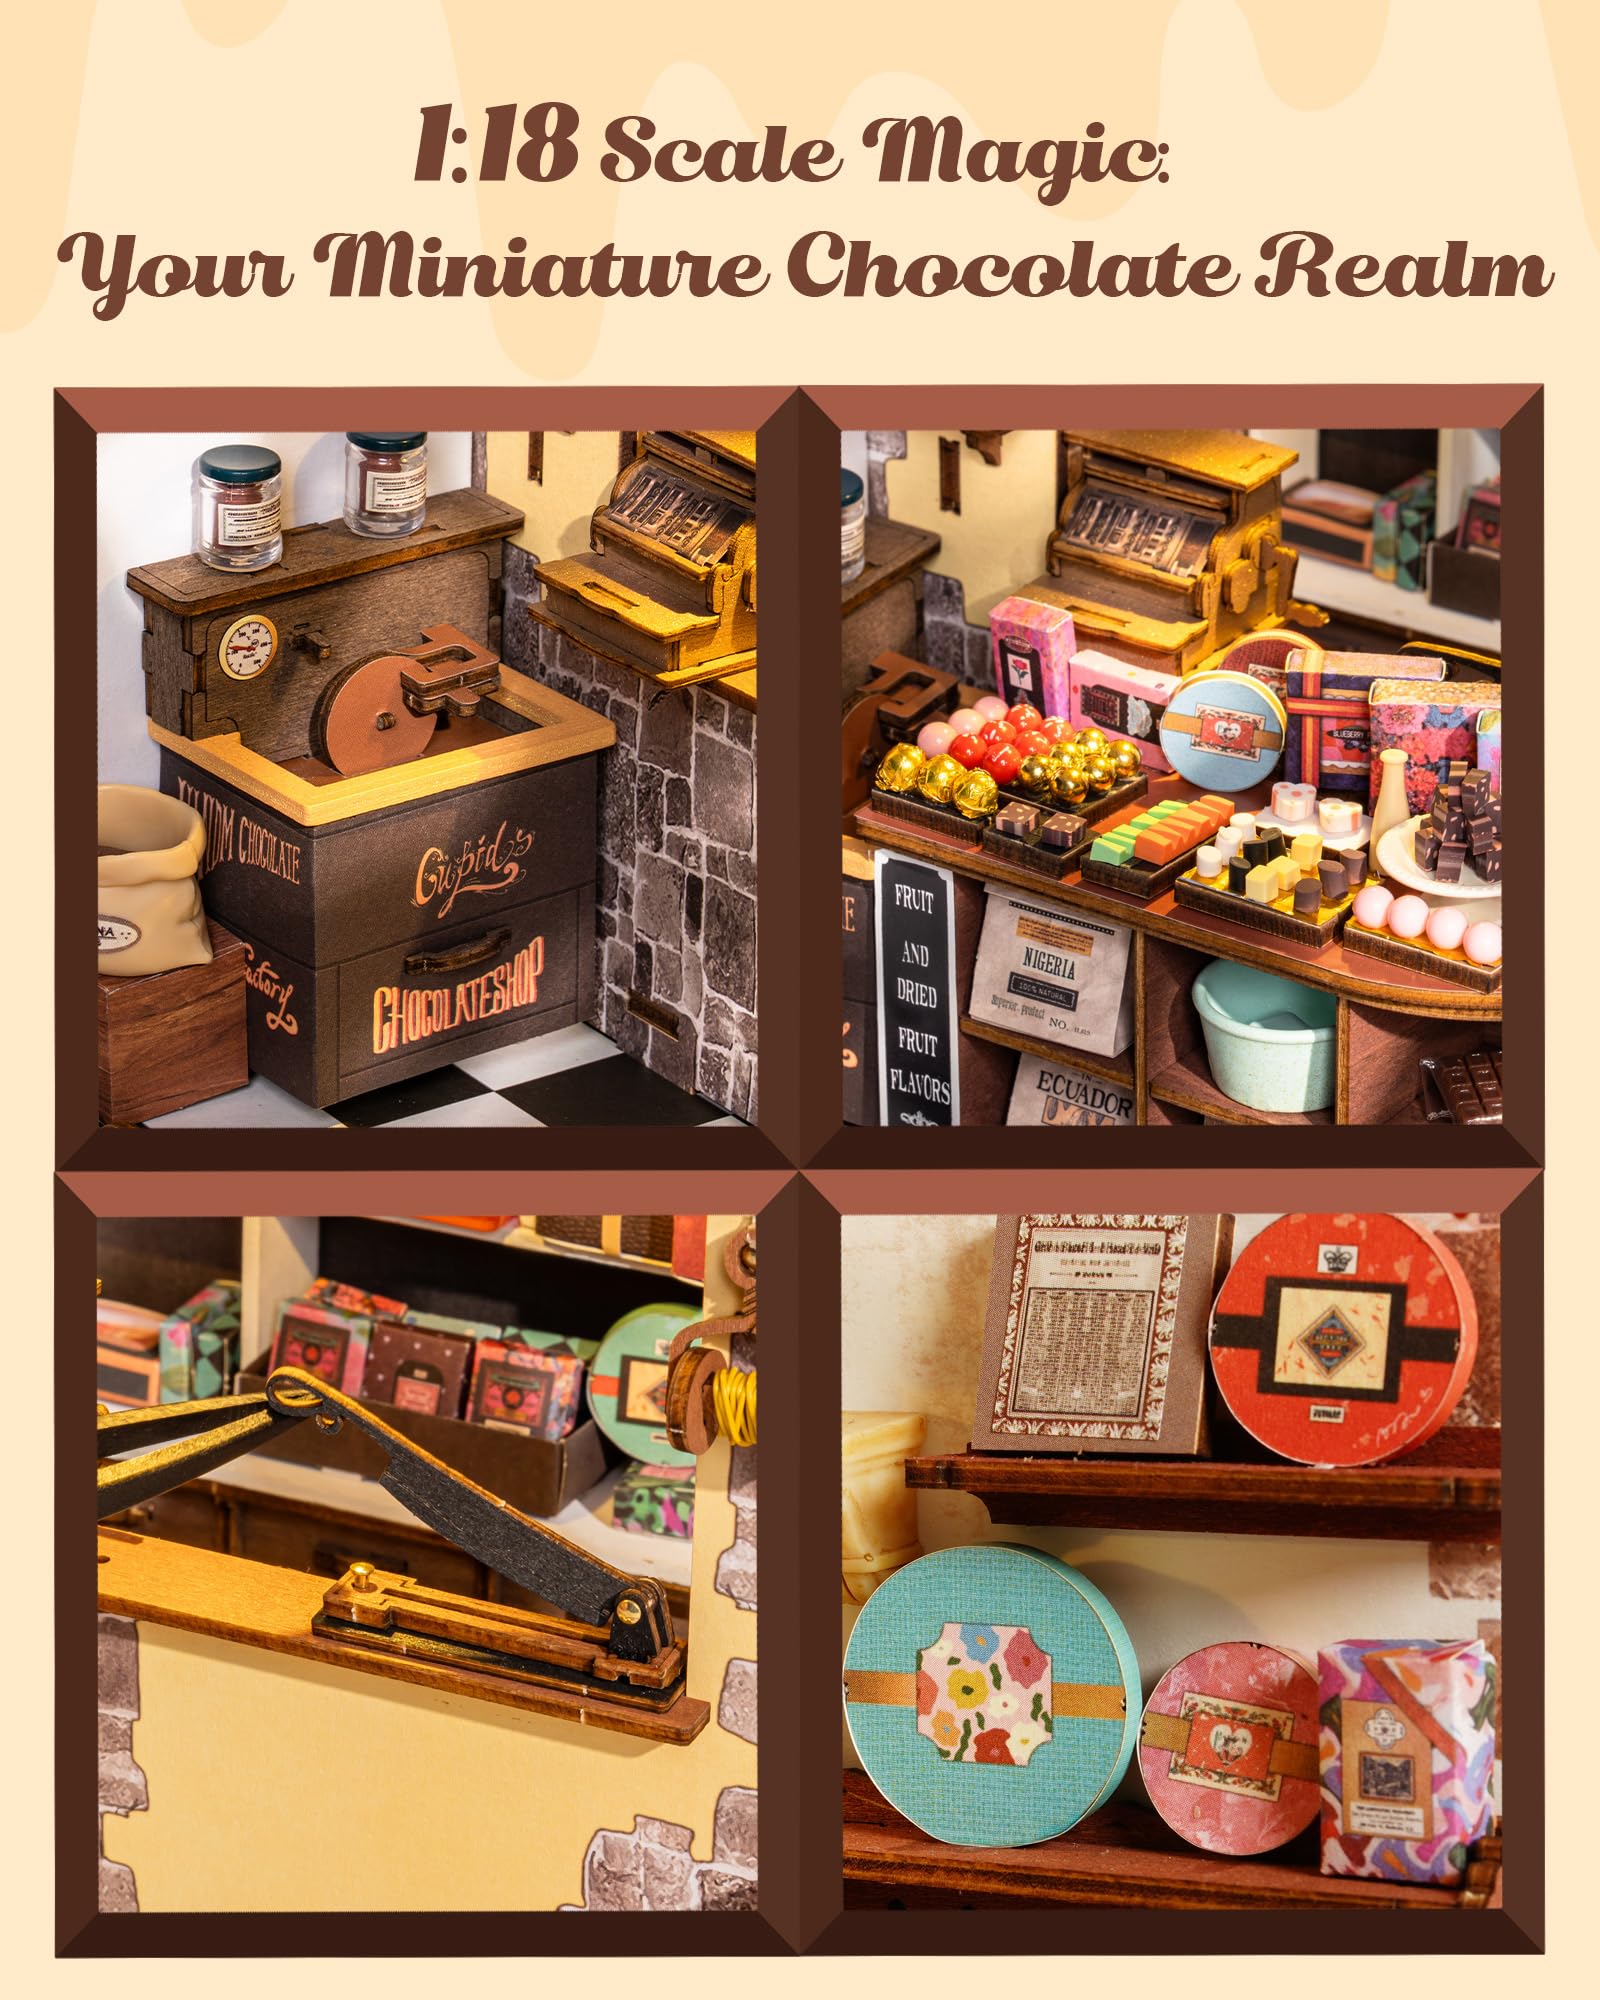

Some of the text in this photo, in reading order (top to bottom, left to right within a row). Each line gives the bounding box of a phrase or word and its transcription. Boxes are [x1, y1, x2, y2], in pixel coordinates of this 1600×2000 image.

[239, 815, 301, 886] CHOCOLATE
[895, 883, 934, 915] FRUIT
[902, 940, 929, 968] AND
[1022, 946, 1076, 981] NIGERIA
[373, 935, 545, 1054] CHOCOLATESHOP
[897, 977, 937, 1009] DRIED
[1019, 982, 1067, 1003] 100% NATURAL
[1049, 1017, 1070, 1032] NO.
[898, 1026, 938, 1058] FRUIT
[890, 1068, 951, 1106] FLAVORS
[1036, 1070, 1133, 1119] ECUADOR
